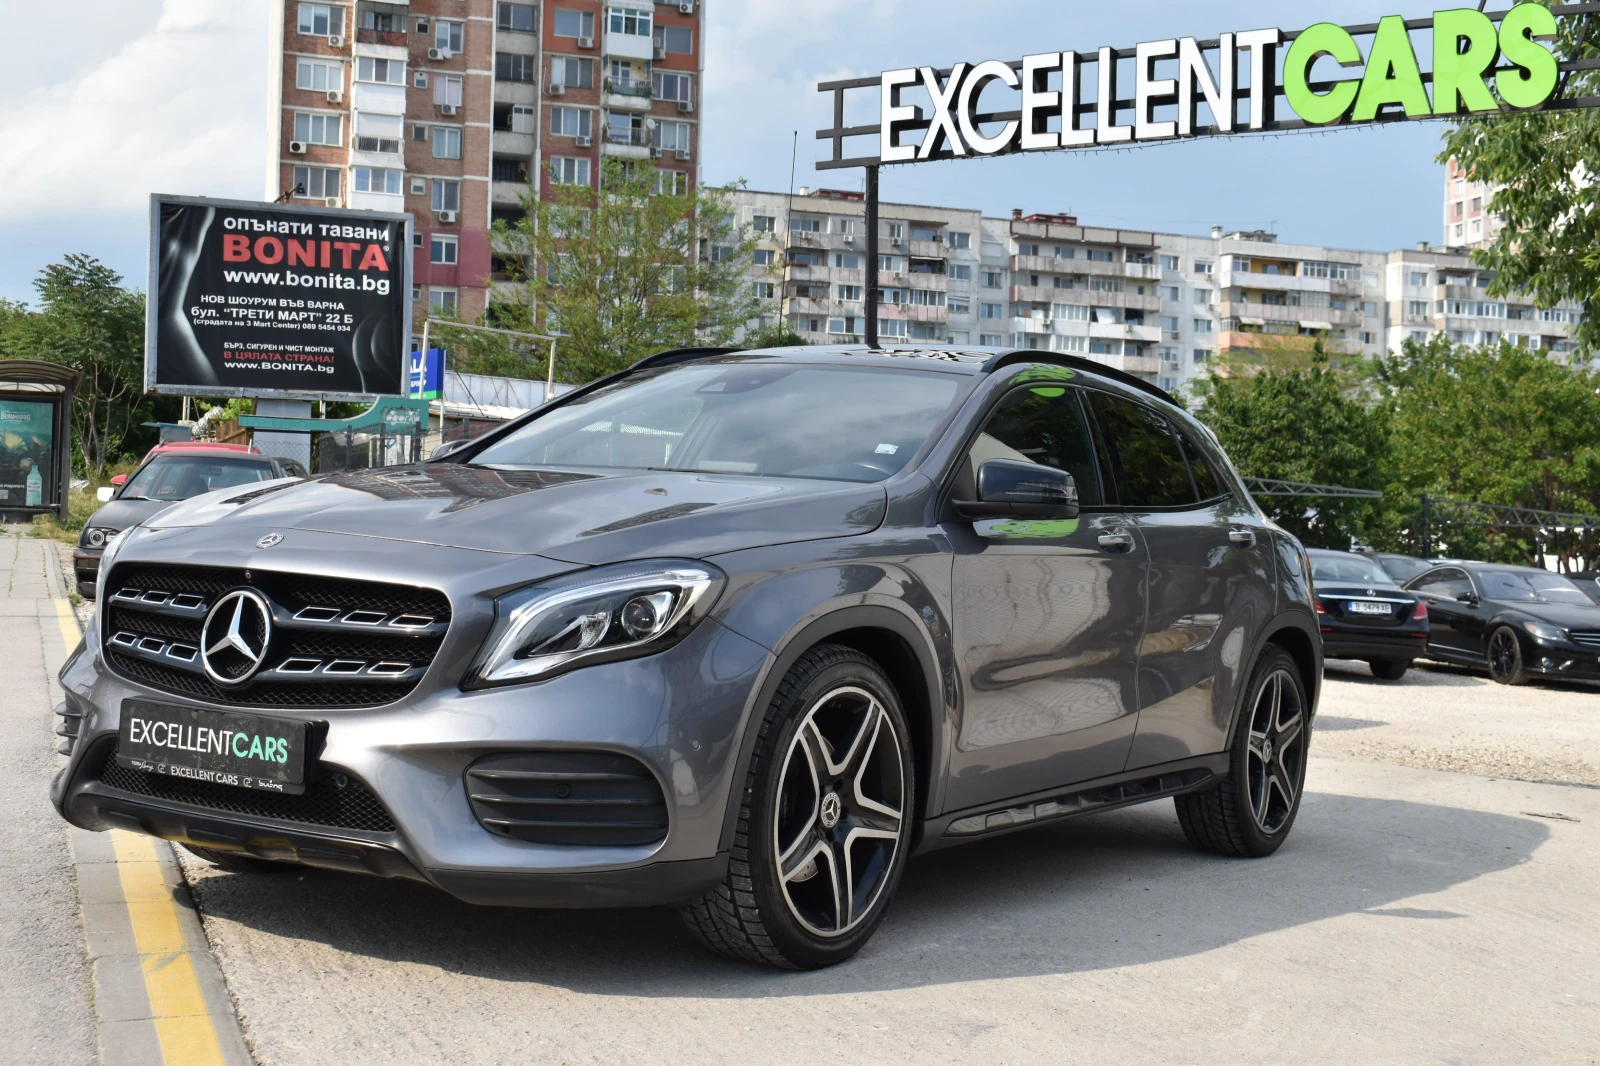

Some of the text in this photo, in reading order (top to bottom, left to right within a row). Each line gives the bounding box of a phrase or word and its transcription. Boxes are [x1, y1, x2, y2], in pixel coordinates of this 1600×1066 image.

[223, 217, 389, 241] опънати тавани
[223, 270, 390, 296] www.bonita.bg
[201, 295, 344, 310] НОВ ШОУРУМ ВЪВ ВАРНА
[191, 307, 220, 318] бул.
[325, 314, 340, 323] 22
[344, 314, 353, 324] Б
[246, 343, 278, 351] СИГУРЕН
[223, 351, 335, 363] В ЦЯЛАТА СТРАНА!
[224, 361, 335, 374] www.BONITA.bg
[130, 718, 288, 764] EXCELLENT CARS
[171, 765, 215, 782] EXCELLENT
[216, 773, 239, 786] CARS
